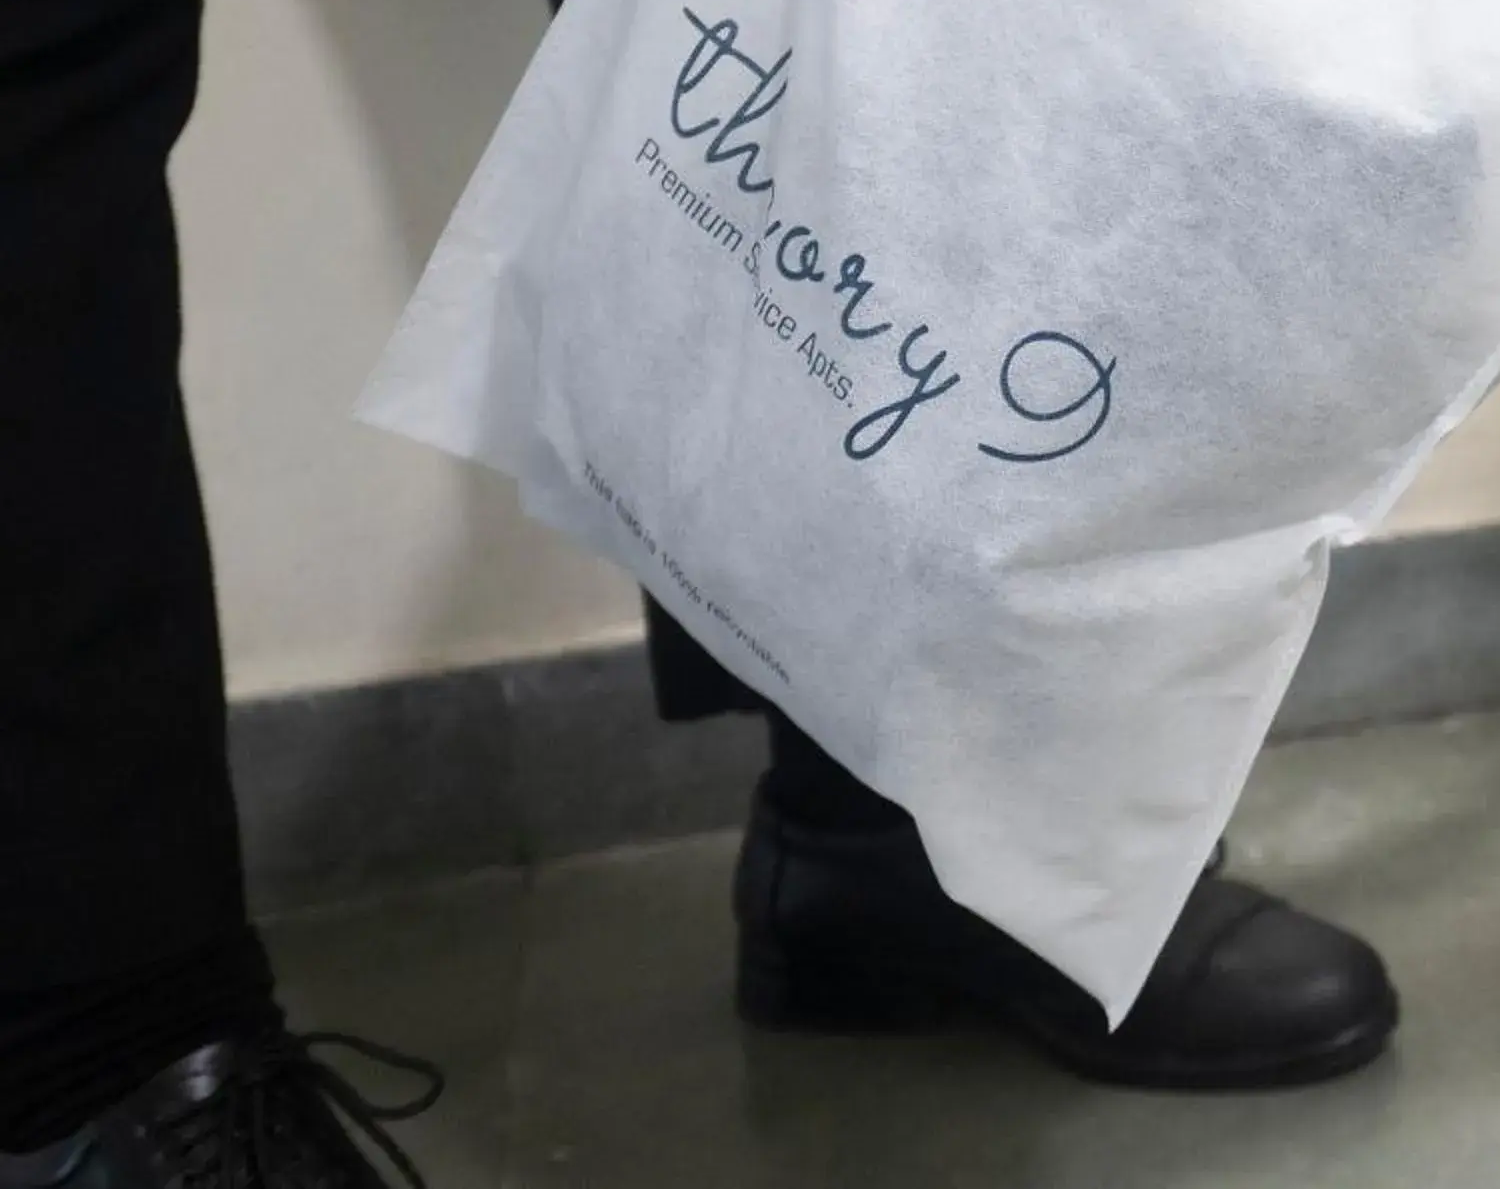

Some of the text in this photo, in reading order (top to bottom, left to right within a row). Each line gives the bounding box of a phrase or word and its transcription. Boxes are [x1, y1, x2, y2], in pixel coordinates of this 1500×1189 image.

[634, 137, 744, 252] Premium
[796, 331, 855, 409] Apts.
[671, 6, 1117, 463] thory 9
